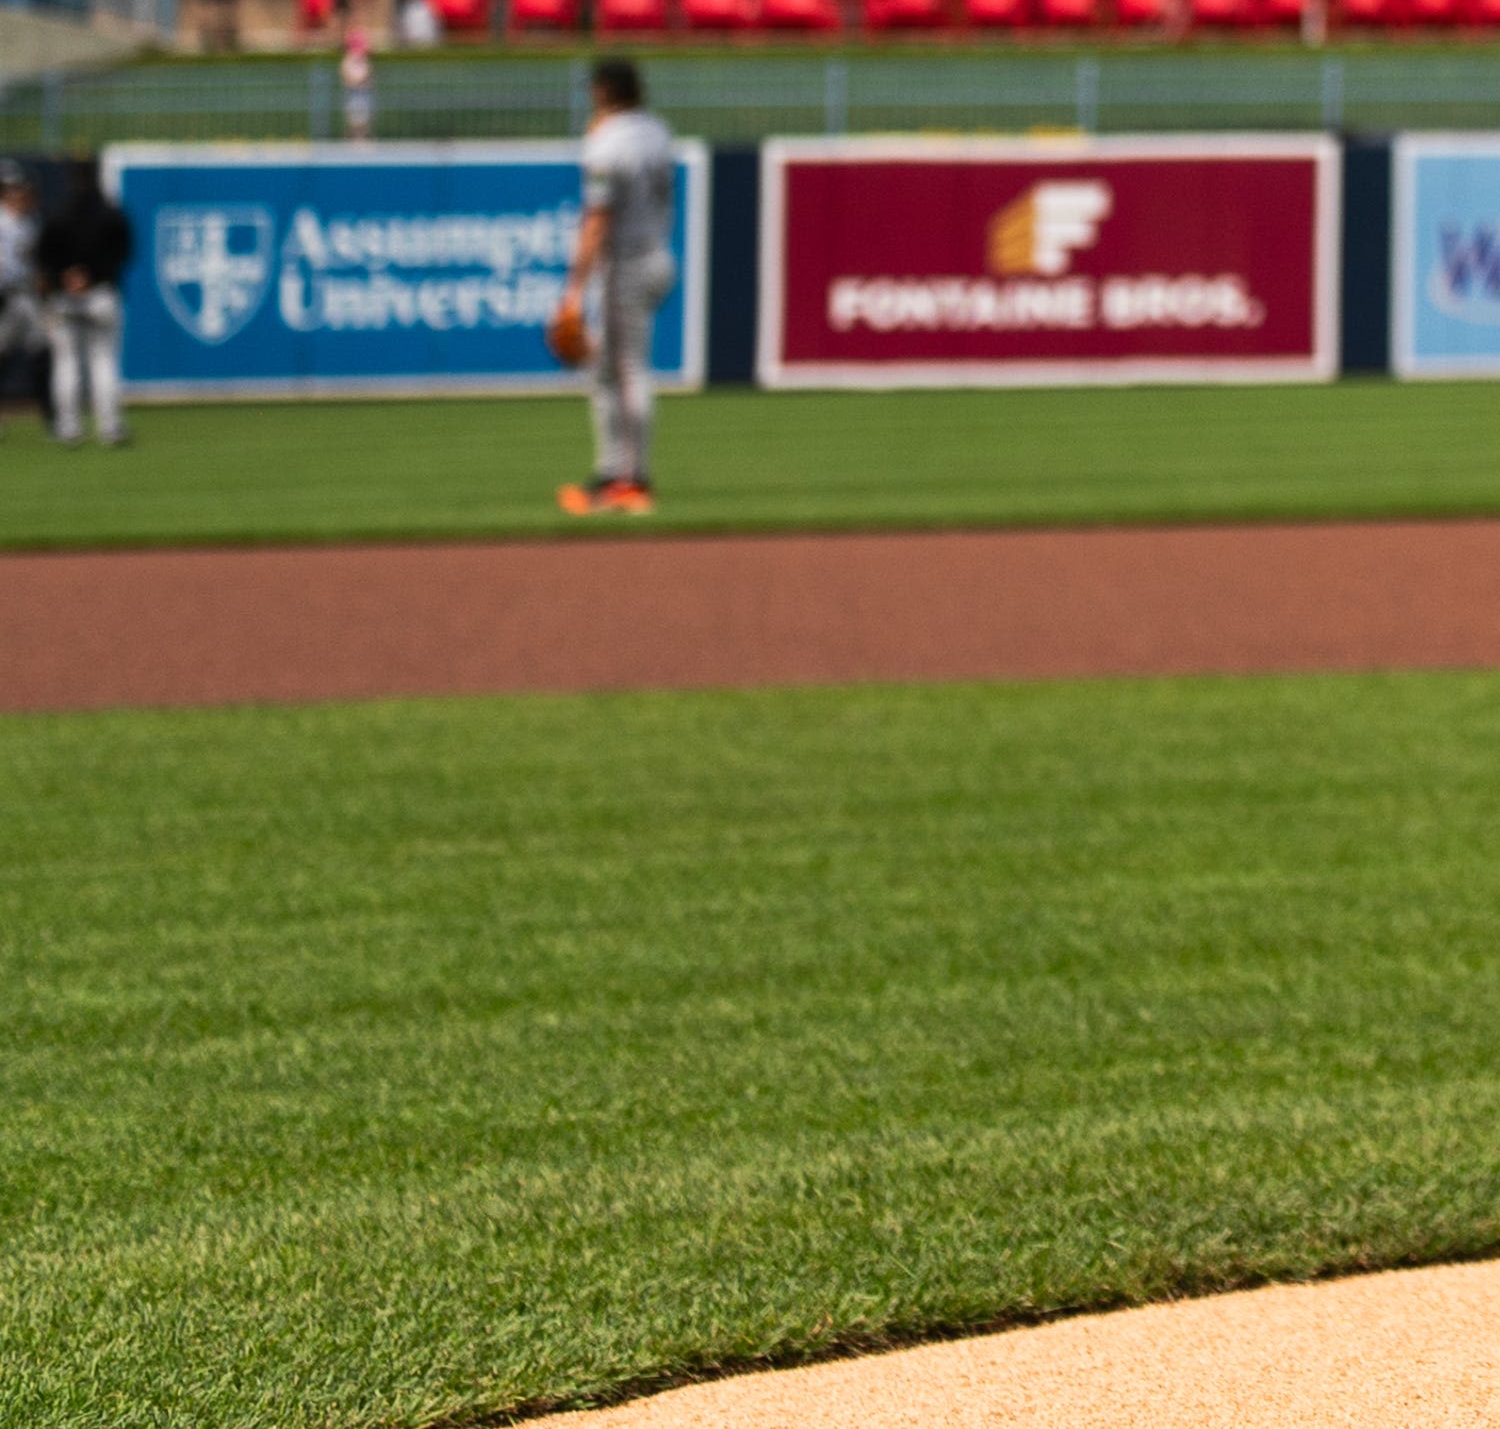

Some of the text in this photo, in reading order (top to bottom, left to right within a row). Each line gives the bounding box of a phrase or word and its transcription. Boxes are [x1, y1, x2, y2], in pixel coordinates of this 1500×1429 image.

[285, 203, 579, 272] Assumpti
[828, 272, 1263, 329] FONTAINE BROS.
